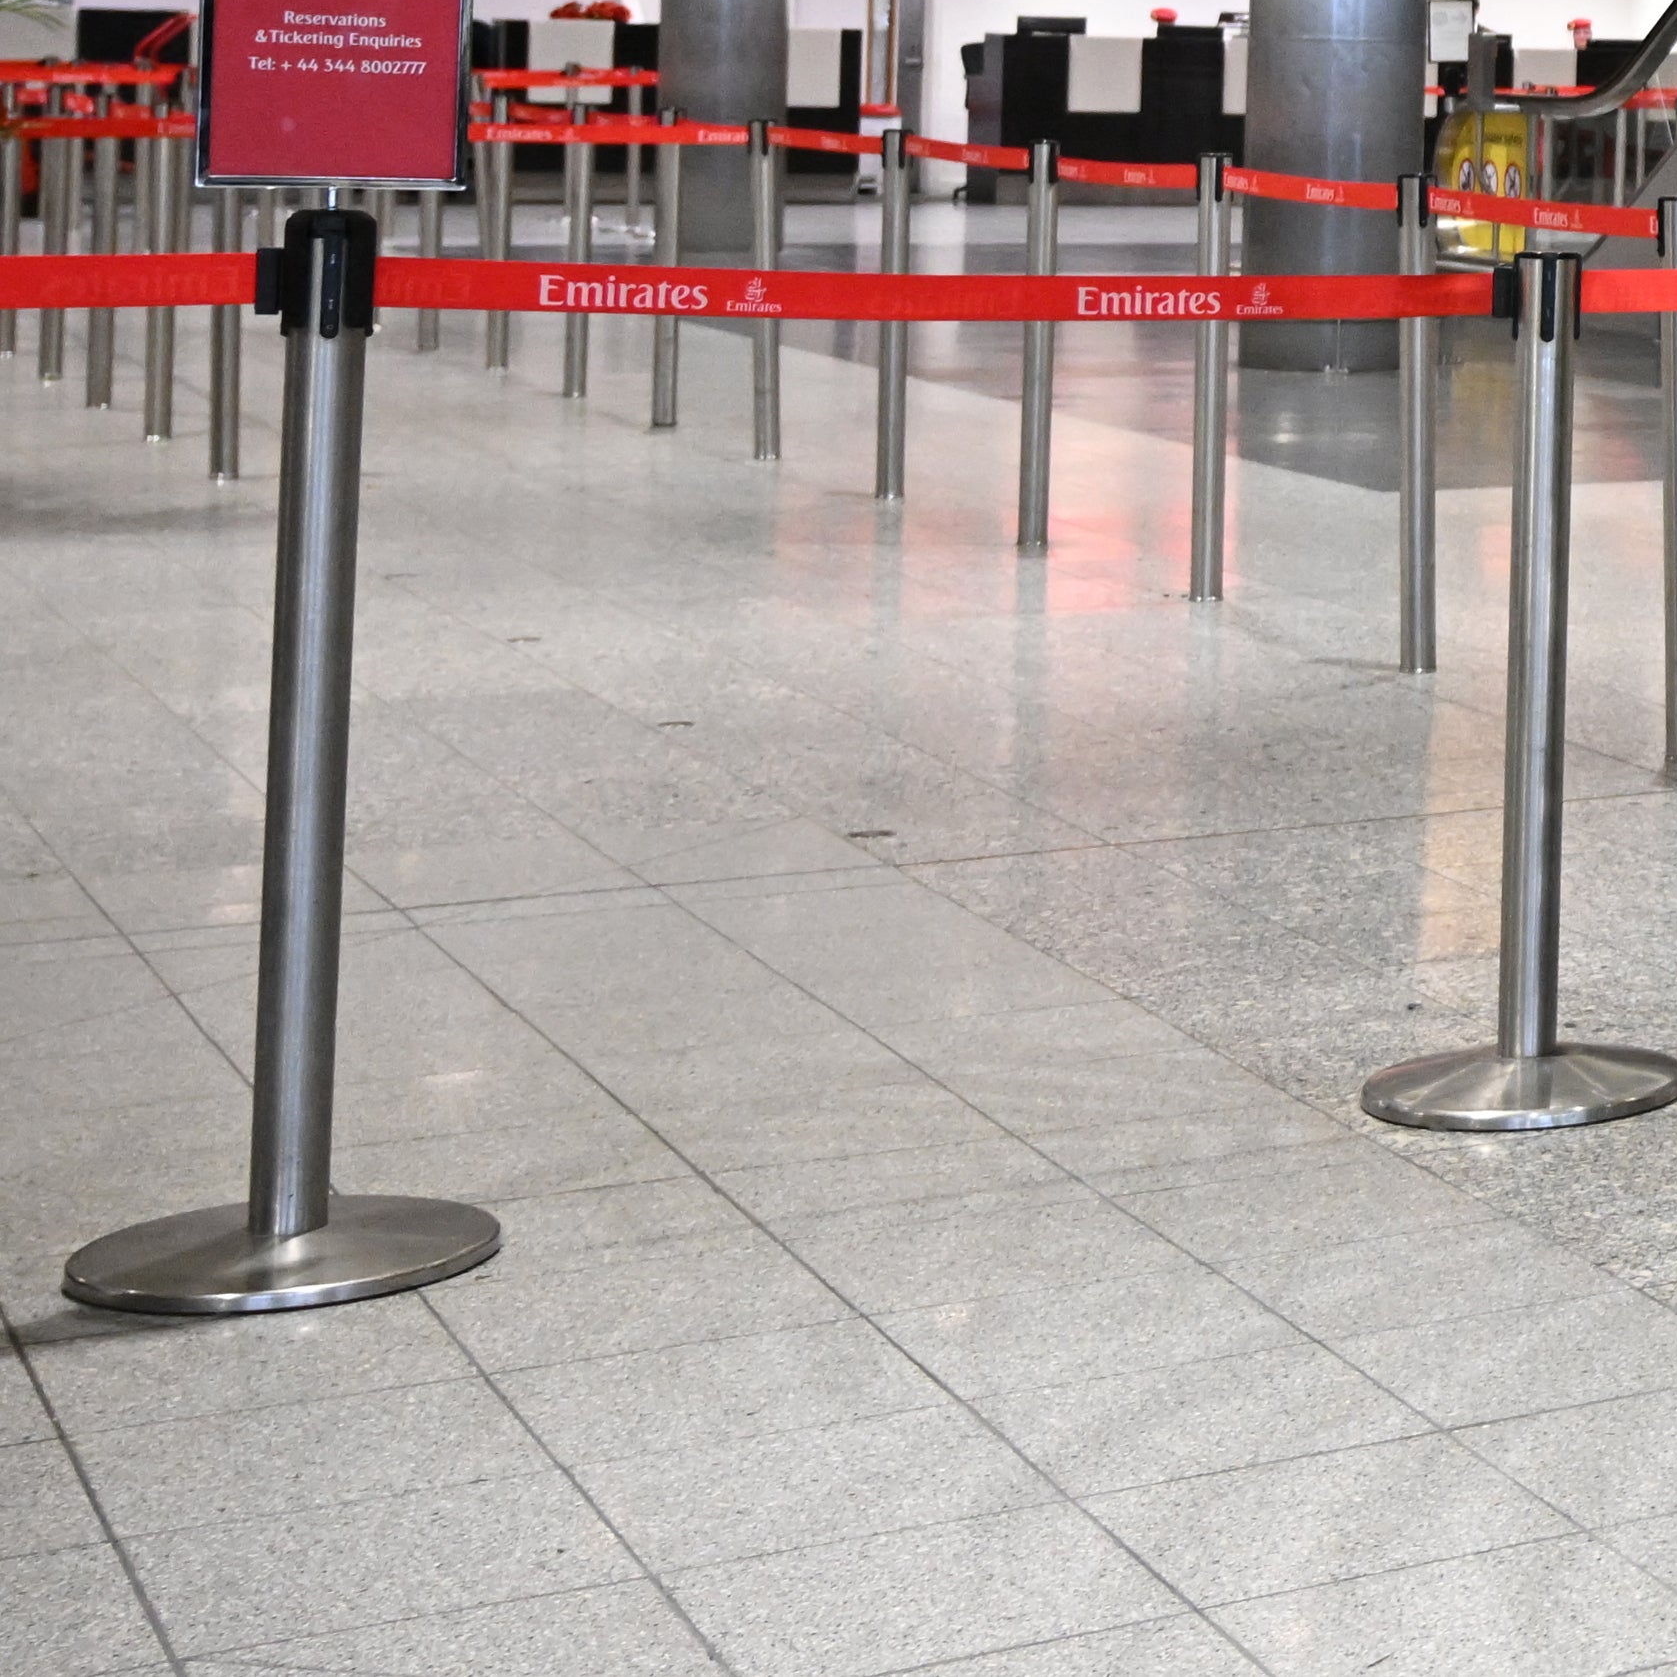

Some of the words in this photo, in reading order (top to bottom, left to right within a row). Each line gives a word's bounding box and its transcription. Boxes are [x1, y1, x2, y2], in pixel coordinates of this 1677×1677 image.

[284, 10, 386, 28] Reservations
[349, 33, 422, 49] Enquiries
[248, 56, 276, 71] Tel:
[297, 59, 318, 72] 44
[324, 60, 355, 73] 344
[360, 61, 427, 75] 8002777
[698, 129, 749, 142] Emirat
[1429, 192, 1461, 212] Emirates
[1533, 207, 1569, 228] Emirates
[539, 274, 708, 310] Emirates
[1077, 285, 1221, 316] Emirates
[726, 300, 782, 313] Emirates
[1236, 304, 1283, 315] Emirates
